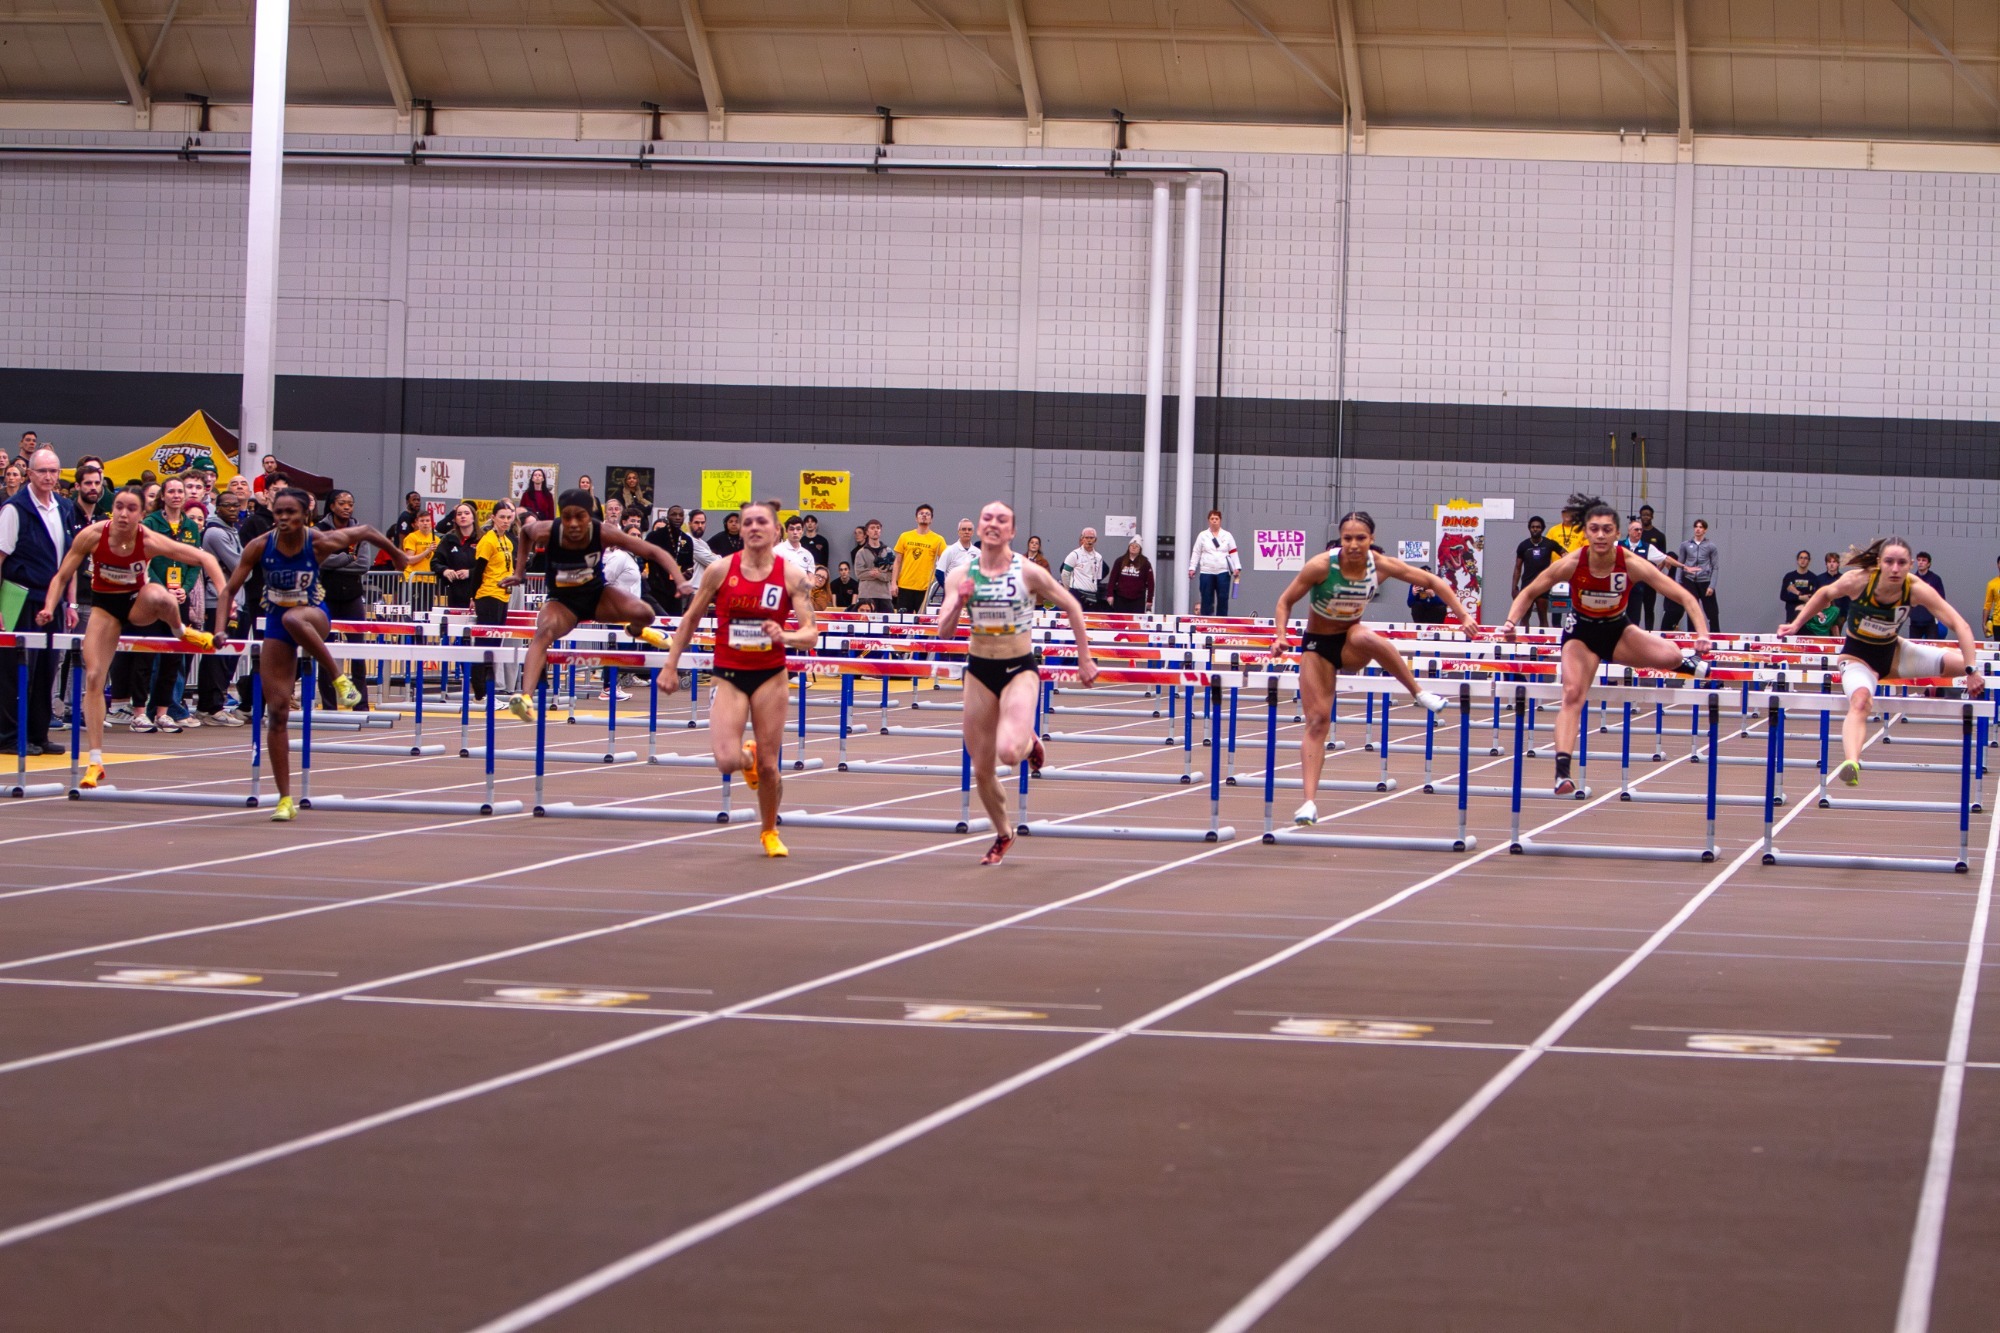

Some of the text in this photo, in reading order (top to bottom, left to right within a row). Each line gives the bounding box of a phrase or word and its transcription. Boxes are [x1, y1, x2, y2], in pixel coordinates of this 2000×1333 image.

[150, 446, 211, 460] BISONS
[1442, 516, 1479, 527] DINOS
[1257, 531, 1304, 543] BLEED
[1260, 543, 1304, 558] WHAT
[1275, 557, 1284, 570] ?
[300, 573, 311, 588] 8
[1006, 576, 1017, 597] 5
[766, 587, 778, 607] 6
[486, 631, 513, 639] 2017
[733, 629, 768, 637] MACDONAL
[1057, 649, 1079, 658] 201
[1714, 654, 1737, 662] 2017
[565, 656, 601, 666] 2017
[1254, 657, 1283, 665] 2017
[804, 663, 840, 674] 2017
[1452, 664, 1481, 672] 2017
[1050, 672, 1078, 682] 201
